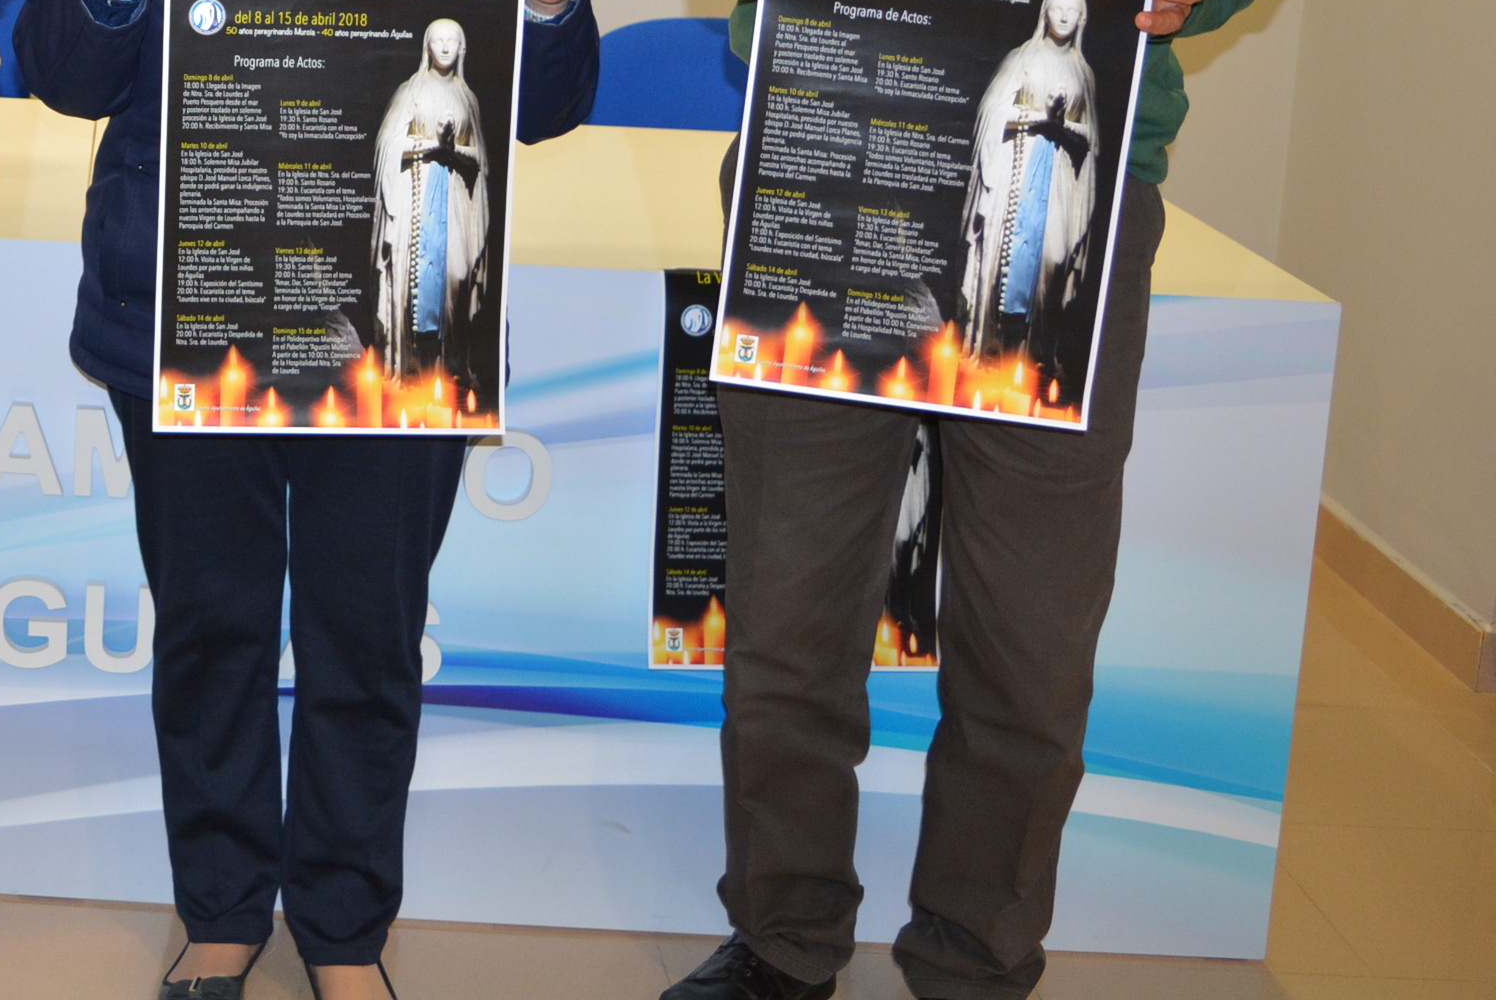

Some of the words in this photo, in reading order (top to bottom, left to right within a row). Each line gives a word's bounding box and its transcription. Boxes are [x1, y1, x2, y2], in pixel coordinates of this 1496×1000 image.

[234, 10, 251, 23] del
[254, 11, 261, 23] 8
[264, 11, 274, 24] al
[278, 12, 291, 24] 15
[295, 12, 308, 25] de
[311, 12, 335, 25] abril
[338, 13, 367, 26] 2018
[833, 1, 882, 19] Programa
[885, 7, 898, 21] de
[900, 10, 931, 24] Actos:
[225, 26, 237, 34] 50
[254, 27, 293, 37] peregrinando
[321, 28, 333, 36] 40
[350, 29, 389, 39] peregrinando
[233, 55, 279, 70] Programa
[282, 55, 295, 67] de
[297, 56, 325, 68] Actos:
[697, 270, 711, 284] La
